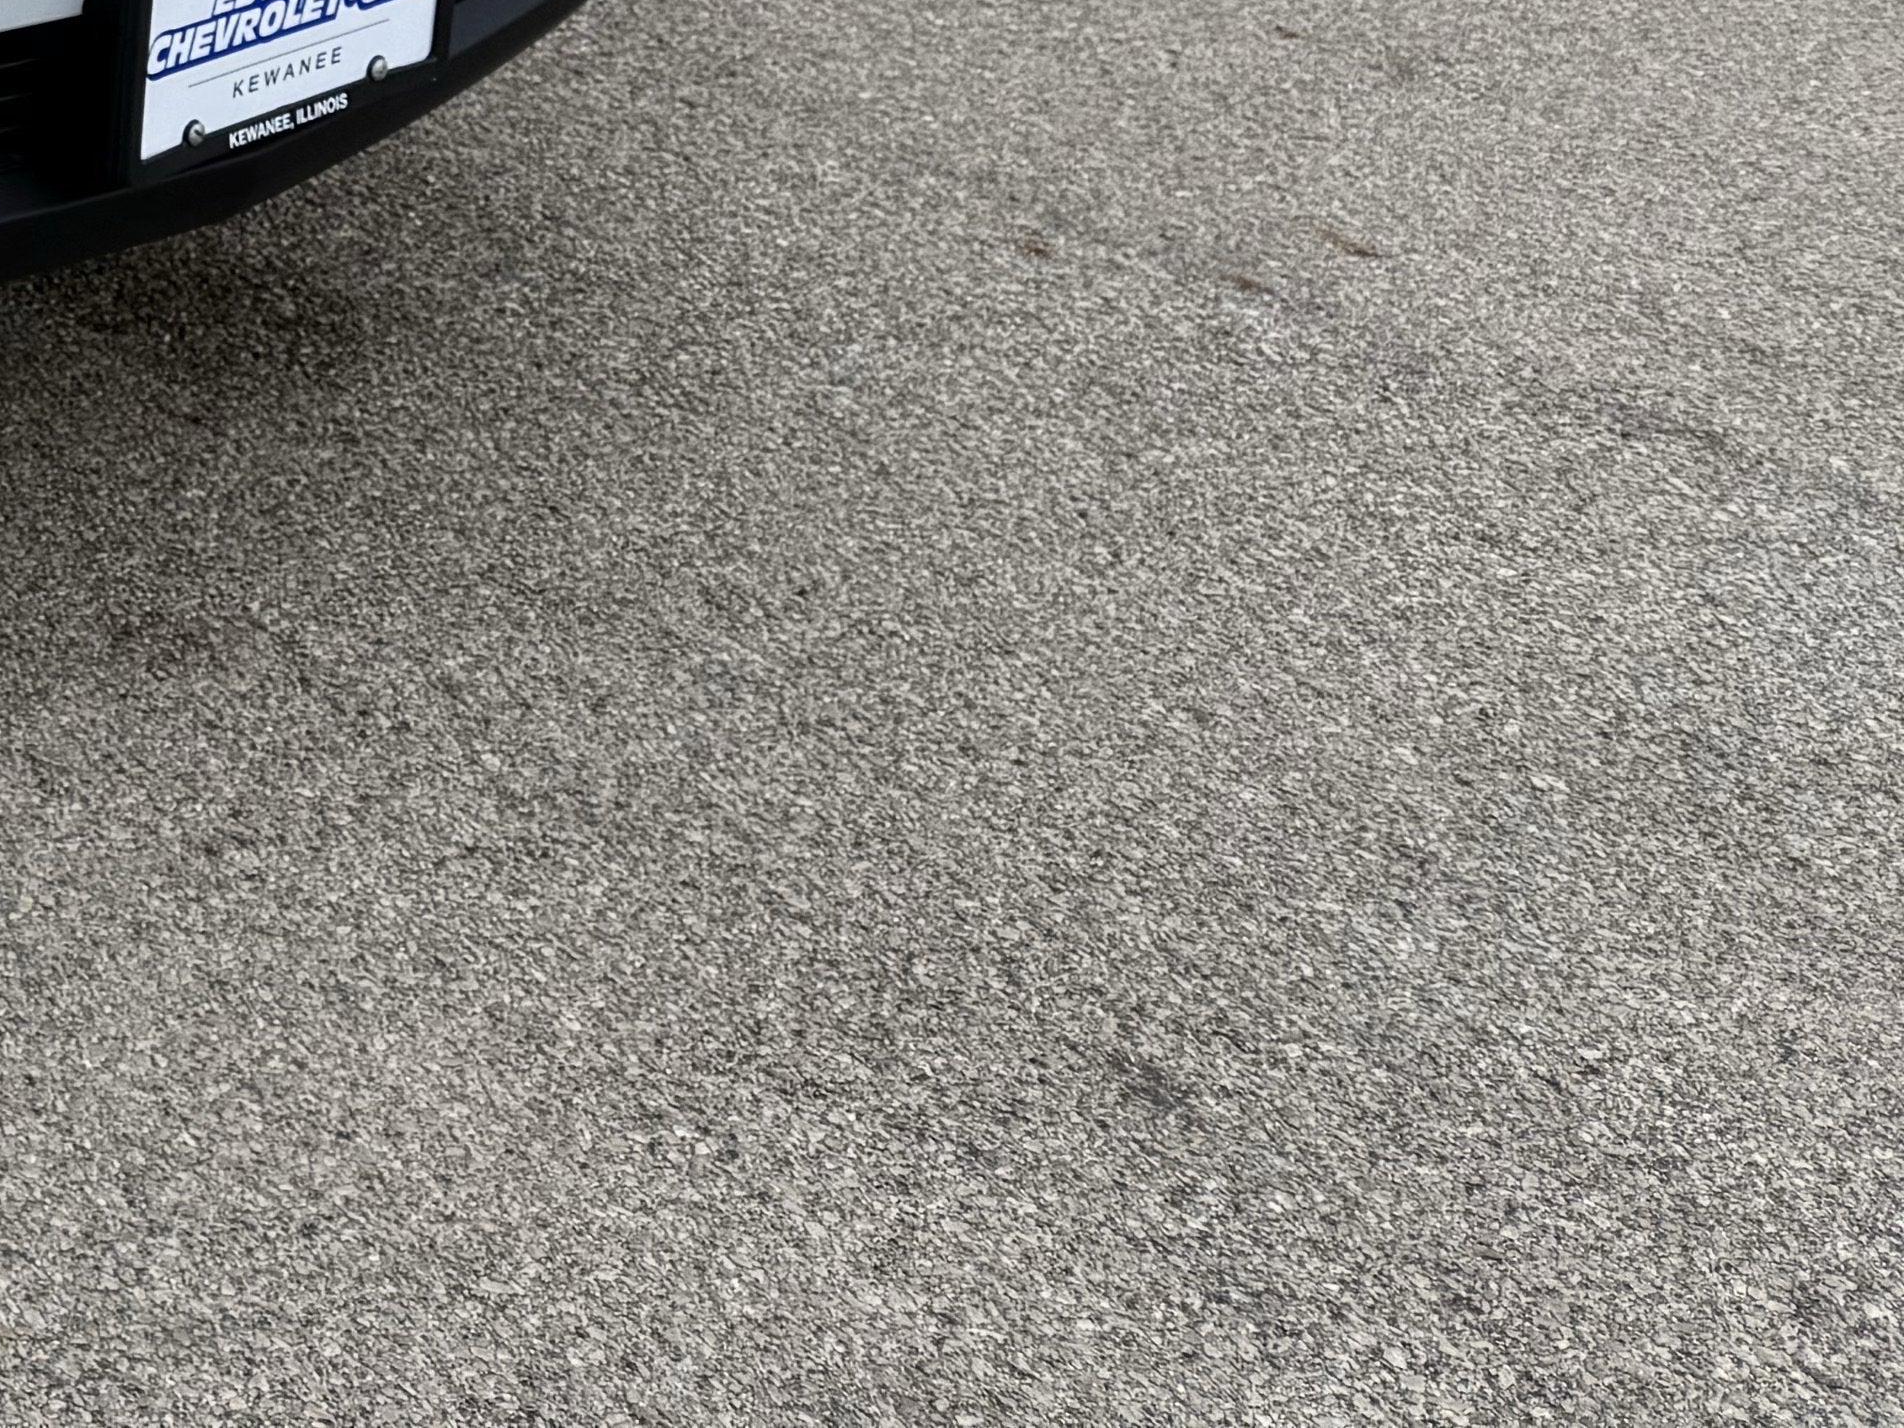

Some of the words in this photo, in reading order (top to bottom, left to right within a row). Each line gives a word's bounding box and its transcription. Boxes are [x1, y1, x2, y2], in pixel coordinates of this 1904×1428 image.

[231, 46, 343, 99] KEWANEE
[228, 113, 295, 149] KEWANEE,
[295, 92, 349, 126] ILLINOIS
